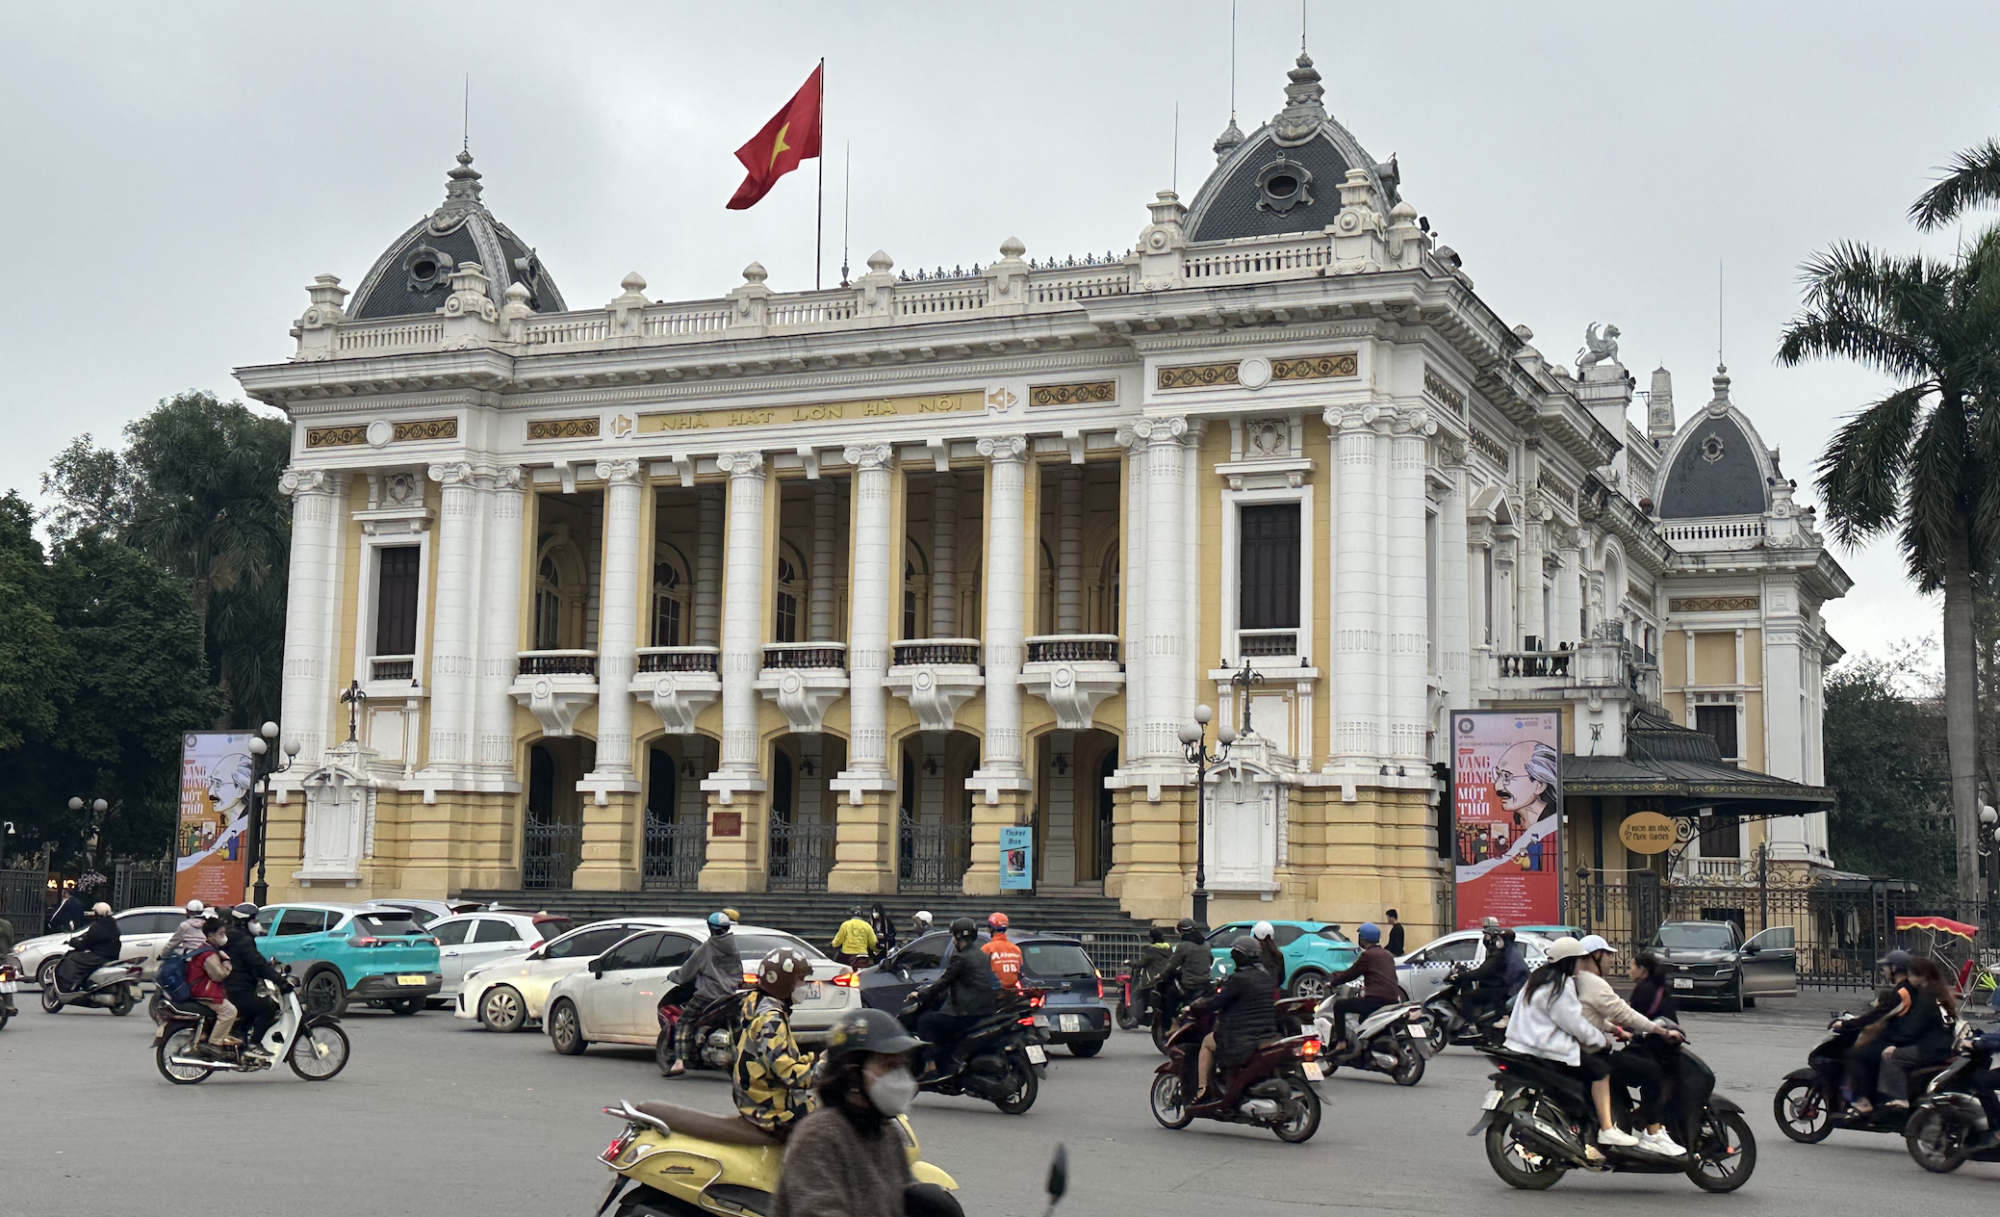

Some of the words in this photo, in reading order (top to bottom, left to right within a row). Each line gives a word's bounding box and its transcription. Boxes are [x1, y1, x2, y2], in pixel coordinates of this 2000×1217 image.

[660, 412, 709, 431] NHÀ
[728, 409, 775, 426] HÁT
[863, 398, 898, 416] HÀ
[919, 394, 962, 413] NỘI
[1458, 756, 1490, 768] VANG
[1458, 769, 1492, 784] BÓNG
[182, 789, 203, 802] MỘT
[1458, 785, 1487, 802] MỘT
[1005, 829, 1026, 837] Ticket
